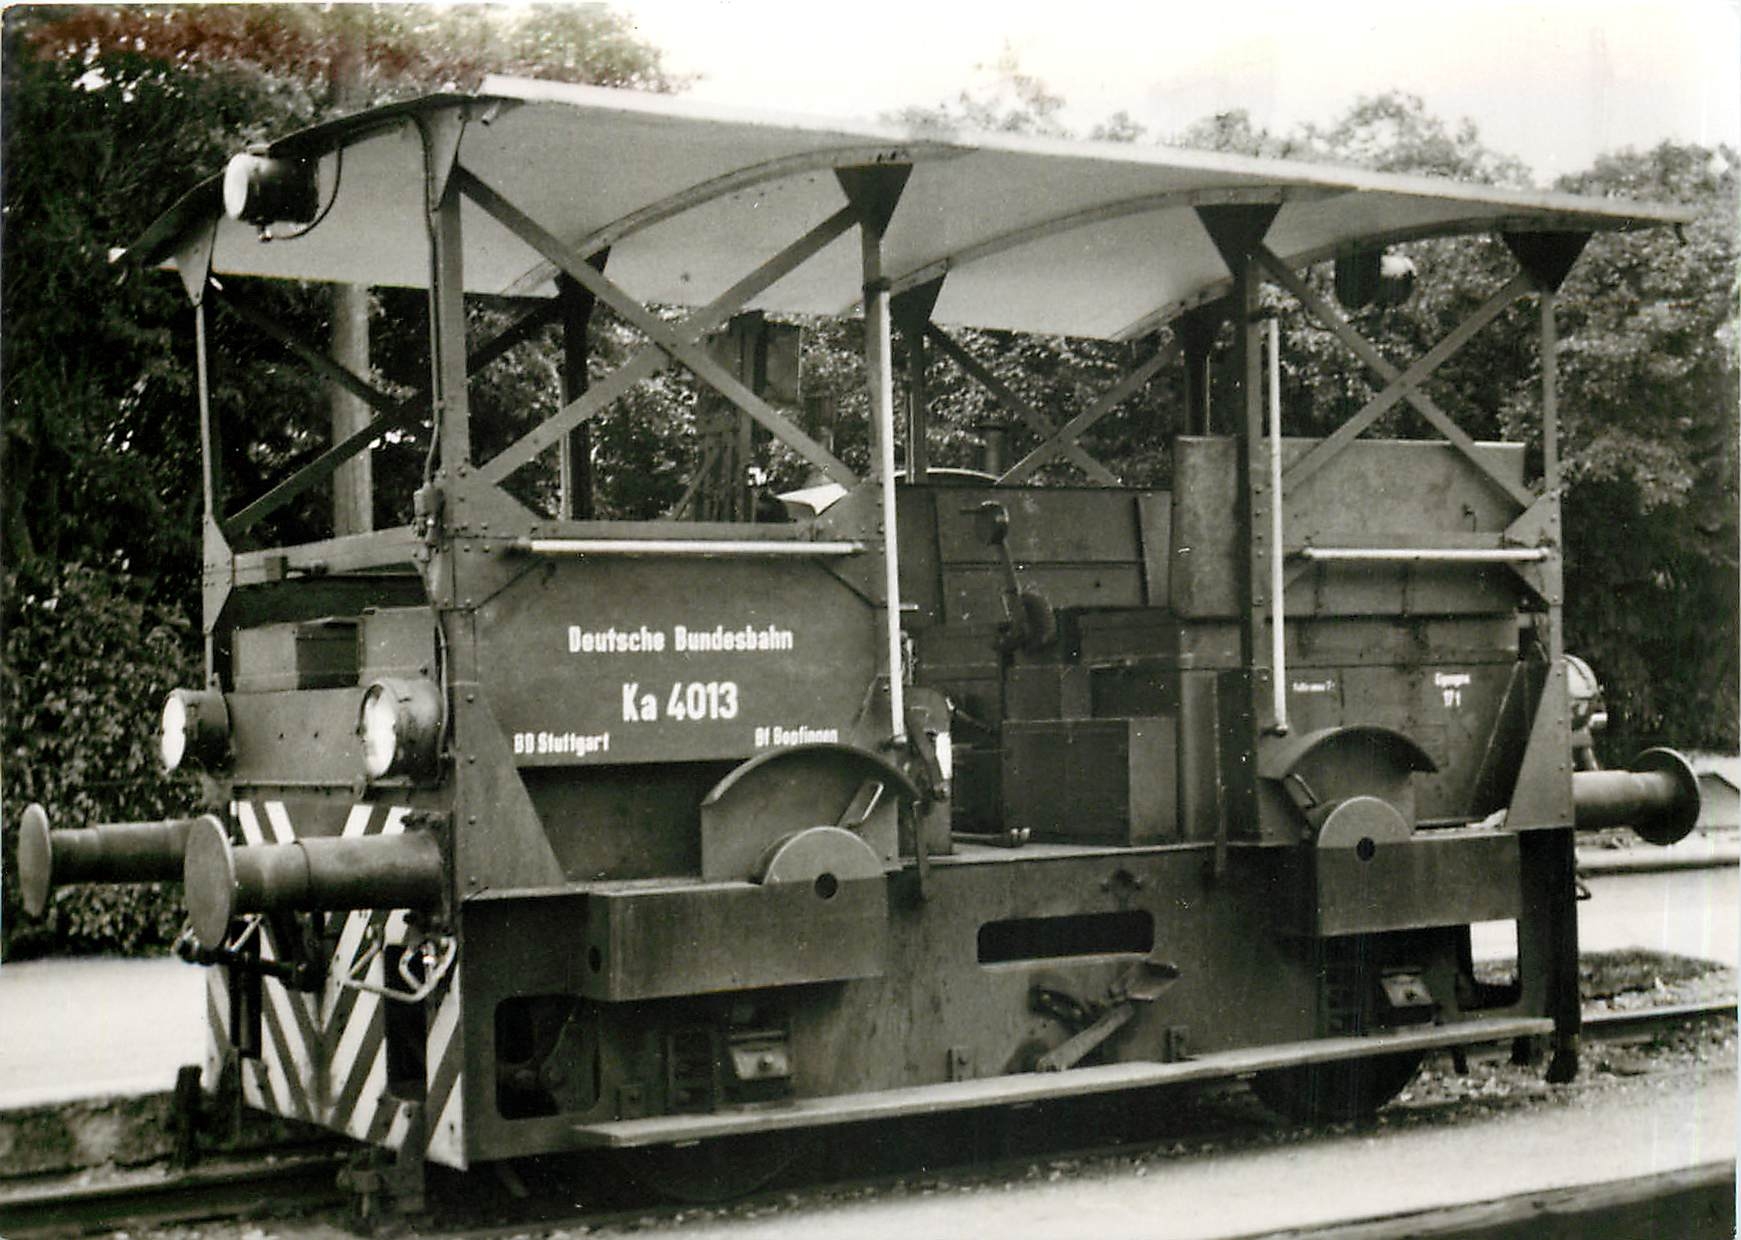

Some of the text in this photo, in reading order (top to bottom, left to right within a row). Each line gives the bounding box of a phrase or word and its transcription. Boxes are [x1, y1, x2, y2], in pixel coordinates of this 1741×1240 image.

[568, 624, 793, 652] Deutsche Bundesbahn
[622, 681, 739, 722] Ka 4013
[537, 732, 610, 757] Stuttgart
